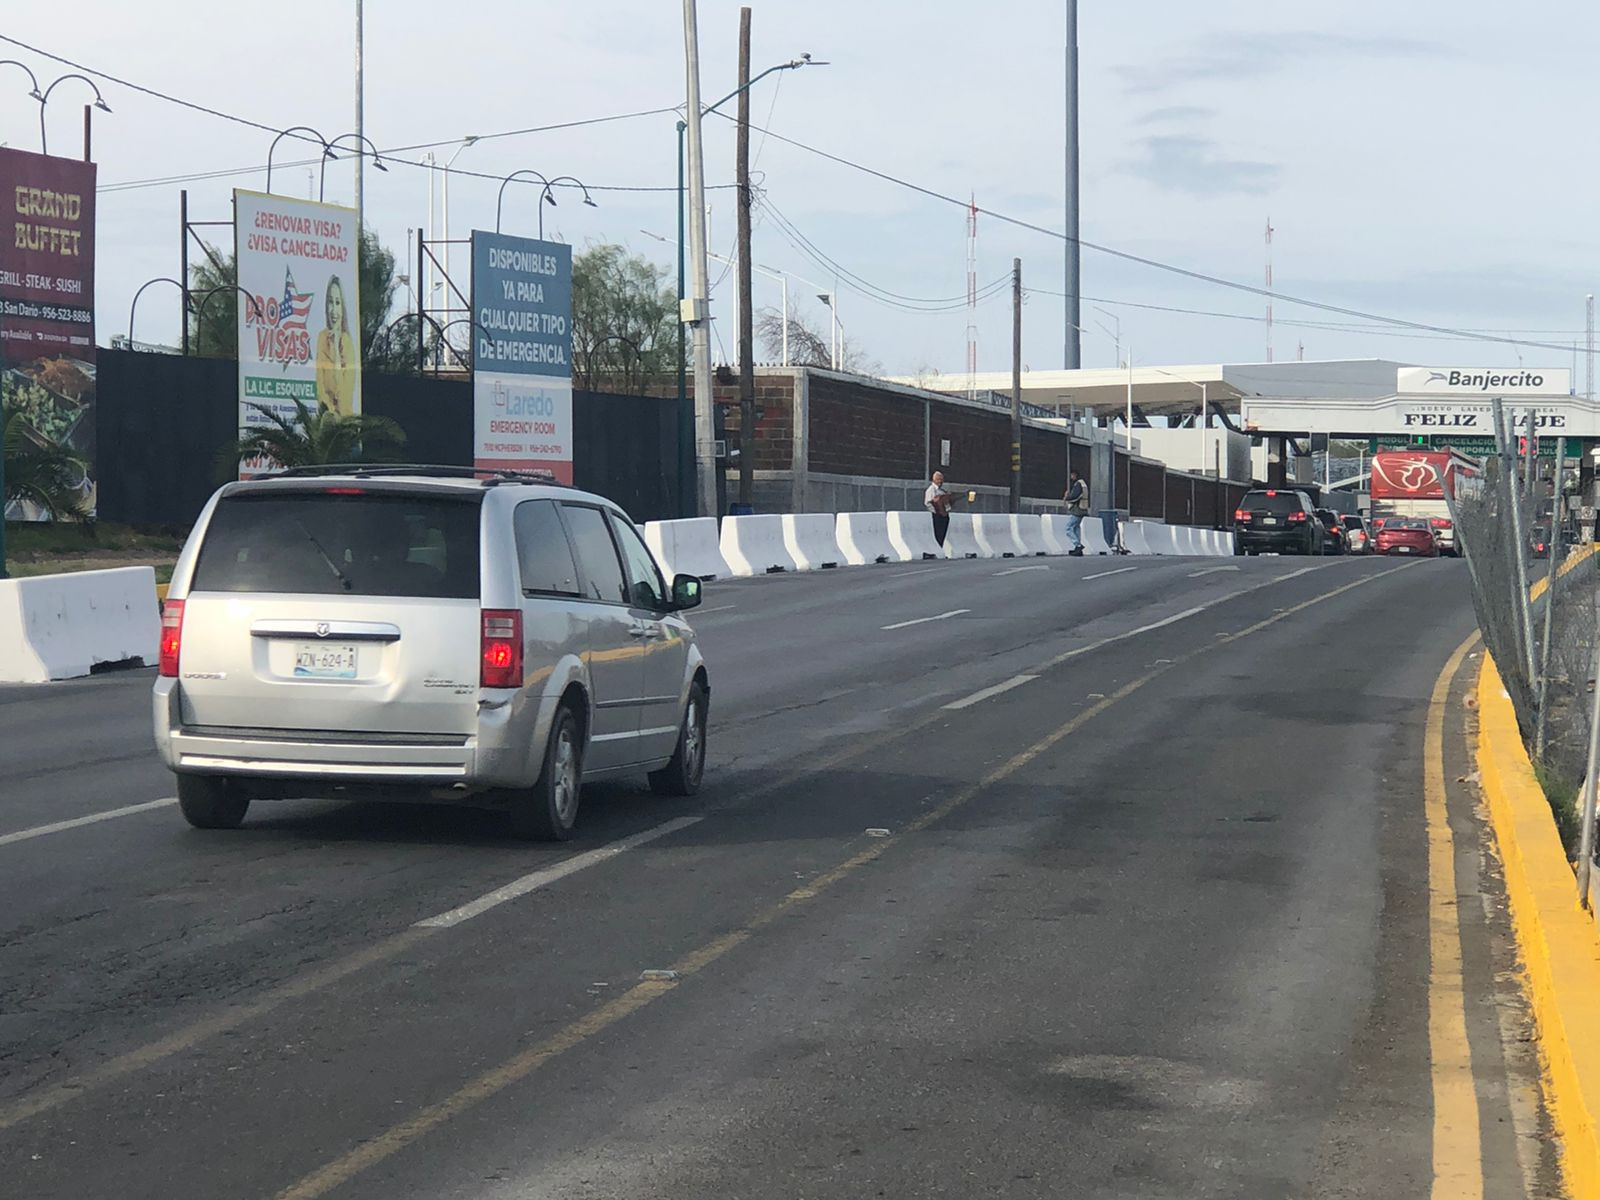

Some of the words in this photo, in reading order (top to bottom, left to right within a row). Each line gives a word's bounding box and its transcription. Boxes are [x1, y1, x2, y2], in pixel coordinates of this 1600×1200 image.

[15, 185, 81, 221] GRAND
[15, 222, 81, 256] BUFFET
[255, 211, 311, 235] ¿RENOVAR
[313, 219, 342, 239] VISA?
[247, 233, 278, 253] ¿VISA
[281, 238, 348, 262] CANCELADA?
[489, 248, 557, 276] DISPONIBLES
[26, 274, 52, 290] STEAK
[56, 278, 81, 294] SUSHI
[502, 279, 515, 300] YA
[517, 281, 544, 303] PARA
[4, 301, 18, 315] San
[19, 303, 38, 317] Dario
[246, 295, 279, 326] PRO
[480, 307, 539, 333] CUALQUIER
[541, 314, 566, 336] TIPO
[256, 327, 309, 361] VISAS
[480, 338, 495, 359] DE
[497, 340, 567, 365] EMERGENCIA.
[246, 380, 258, 394] LA
[260, 381, 274, 395] LIC.
[275, 382, 316, 397] ESQUIVEL
[1448, 370, 1544, 391] Banjercito
[506, 388, 553, 417] Laredo
[490, 420, 533, 434] EMERGENCY
[534, 422, 556, 435] ROOM
[1404, 413, 1477, 427] FELIZ
[1513, 415, 1565, 427] IAJE
